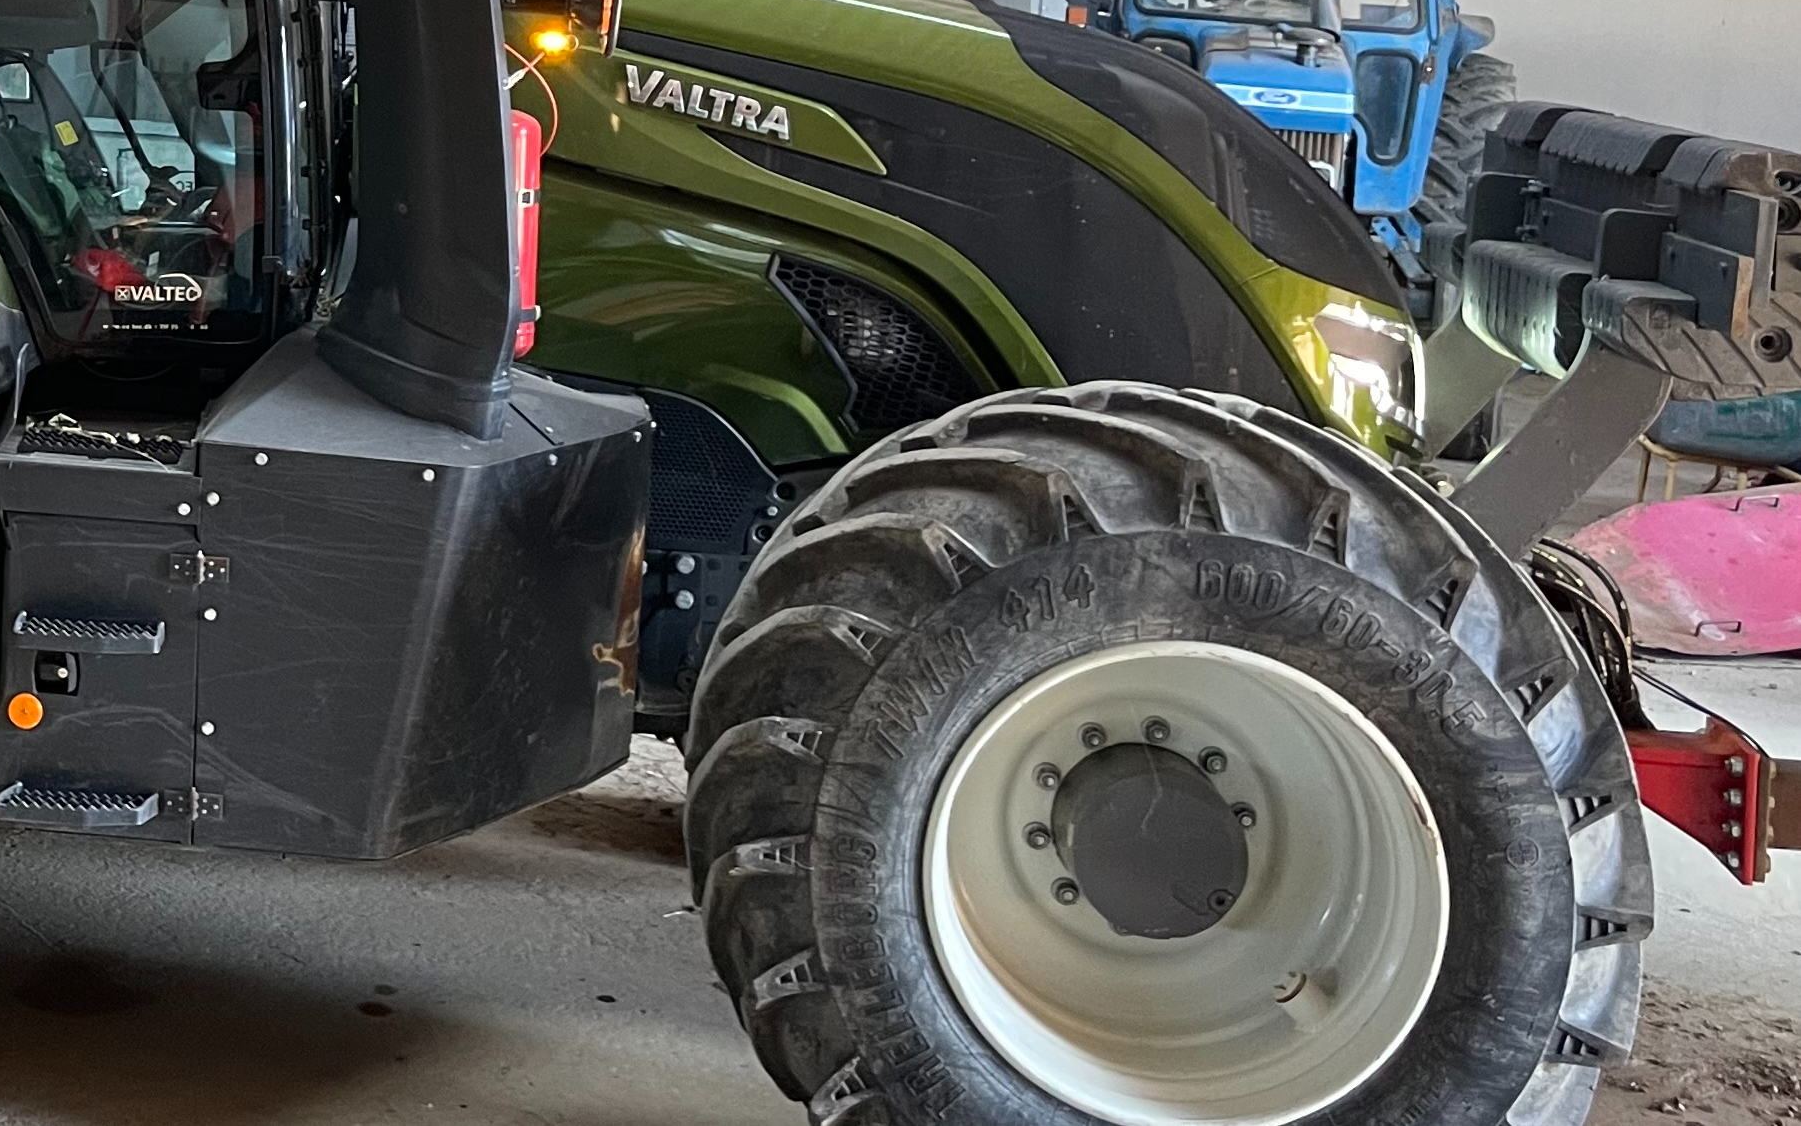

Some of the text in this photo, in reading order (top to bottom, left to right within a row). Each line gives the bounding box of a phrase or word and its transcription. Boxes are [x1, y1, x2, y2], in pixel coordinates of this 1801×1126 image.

[625, 63, 790, 141] VALTRA
[129, 285, 203, 302] VALTEC
[864, 626, 979, 760] TWIN
[1001, 562, 1096, 635] 414
